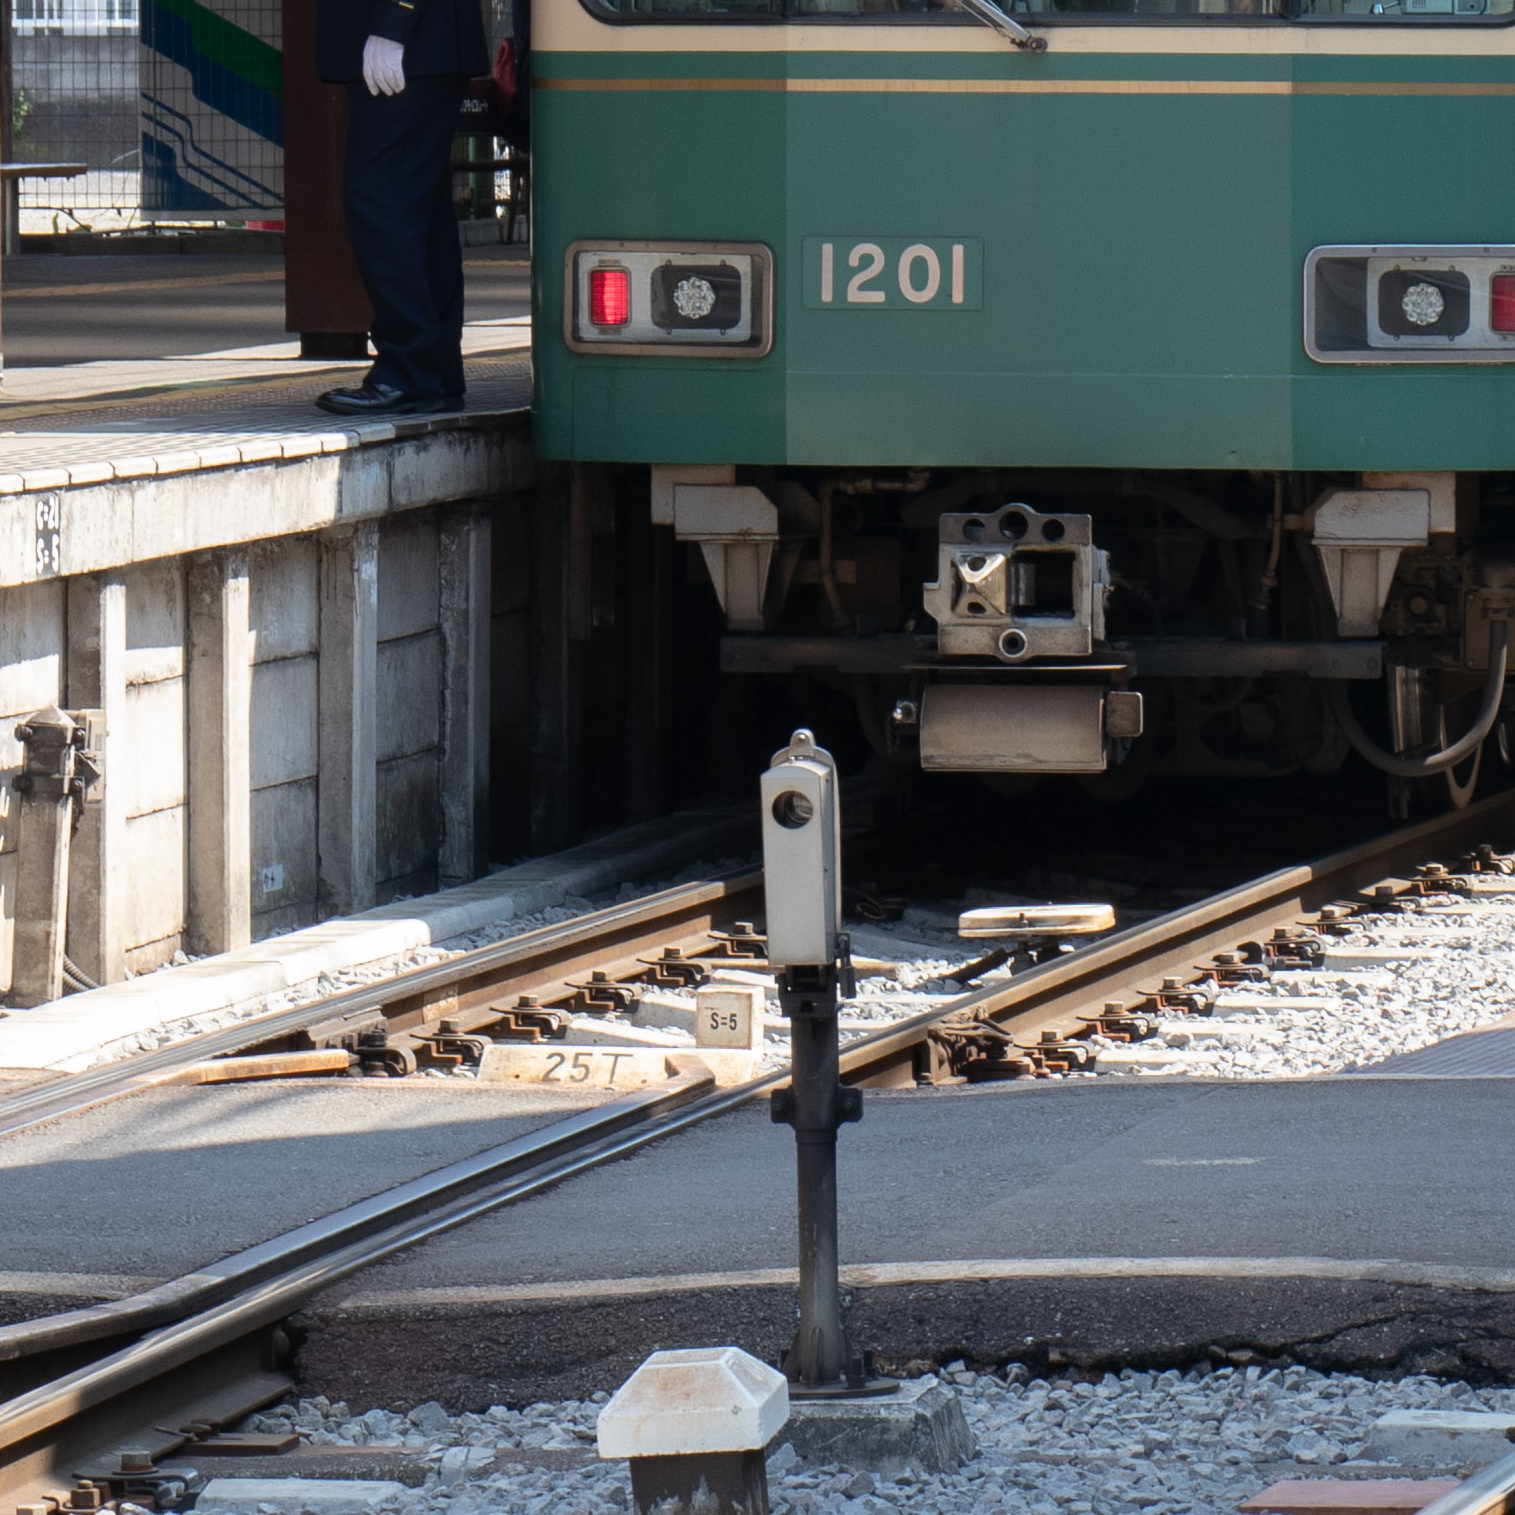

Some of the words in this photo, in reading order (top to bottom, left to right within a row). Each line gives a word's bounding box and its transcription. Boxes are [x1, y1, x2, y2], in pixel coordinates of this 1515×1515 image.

[821, 242, 964, 304] 1201
[710, 1012, 738, 1032] S=5
[541, 1052, 634, 1085] 25T
